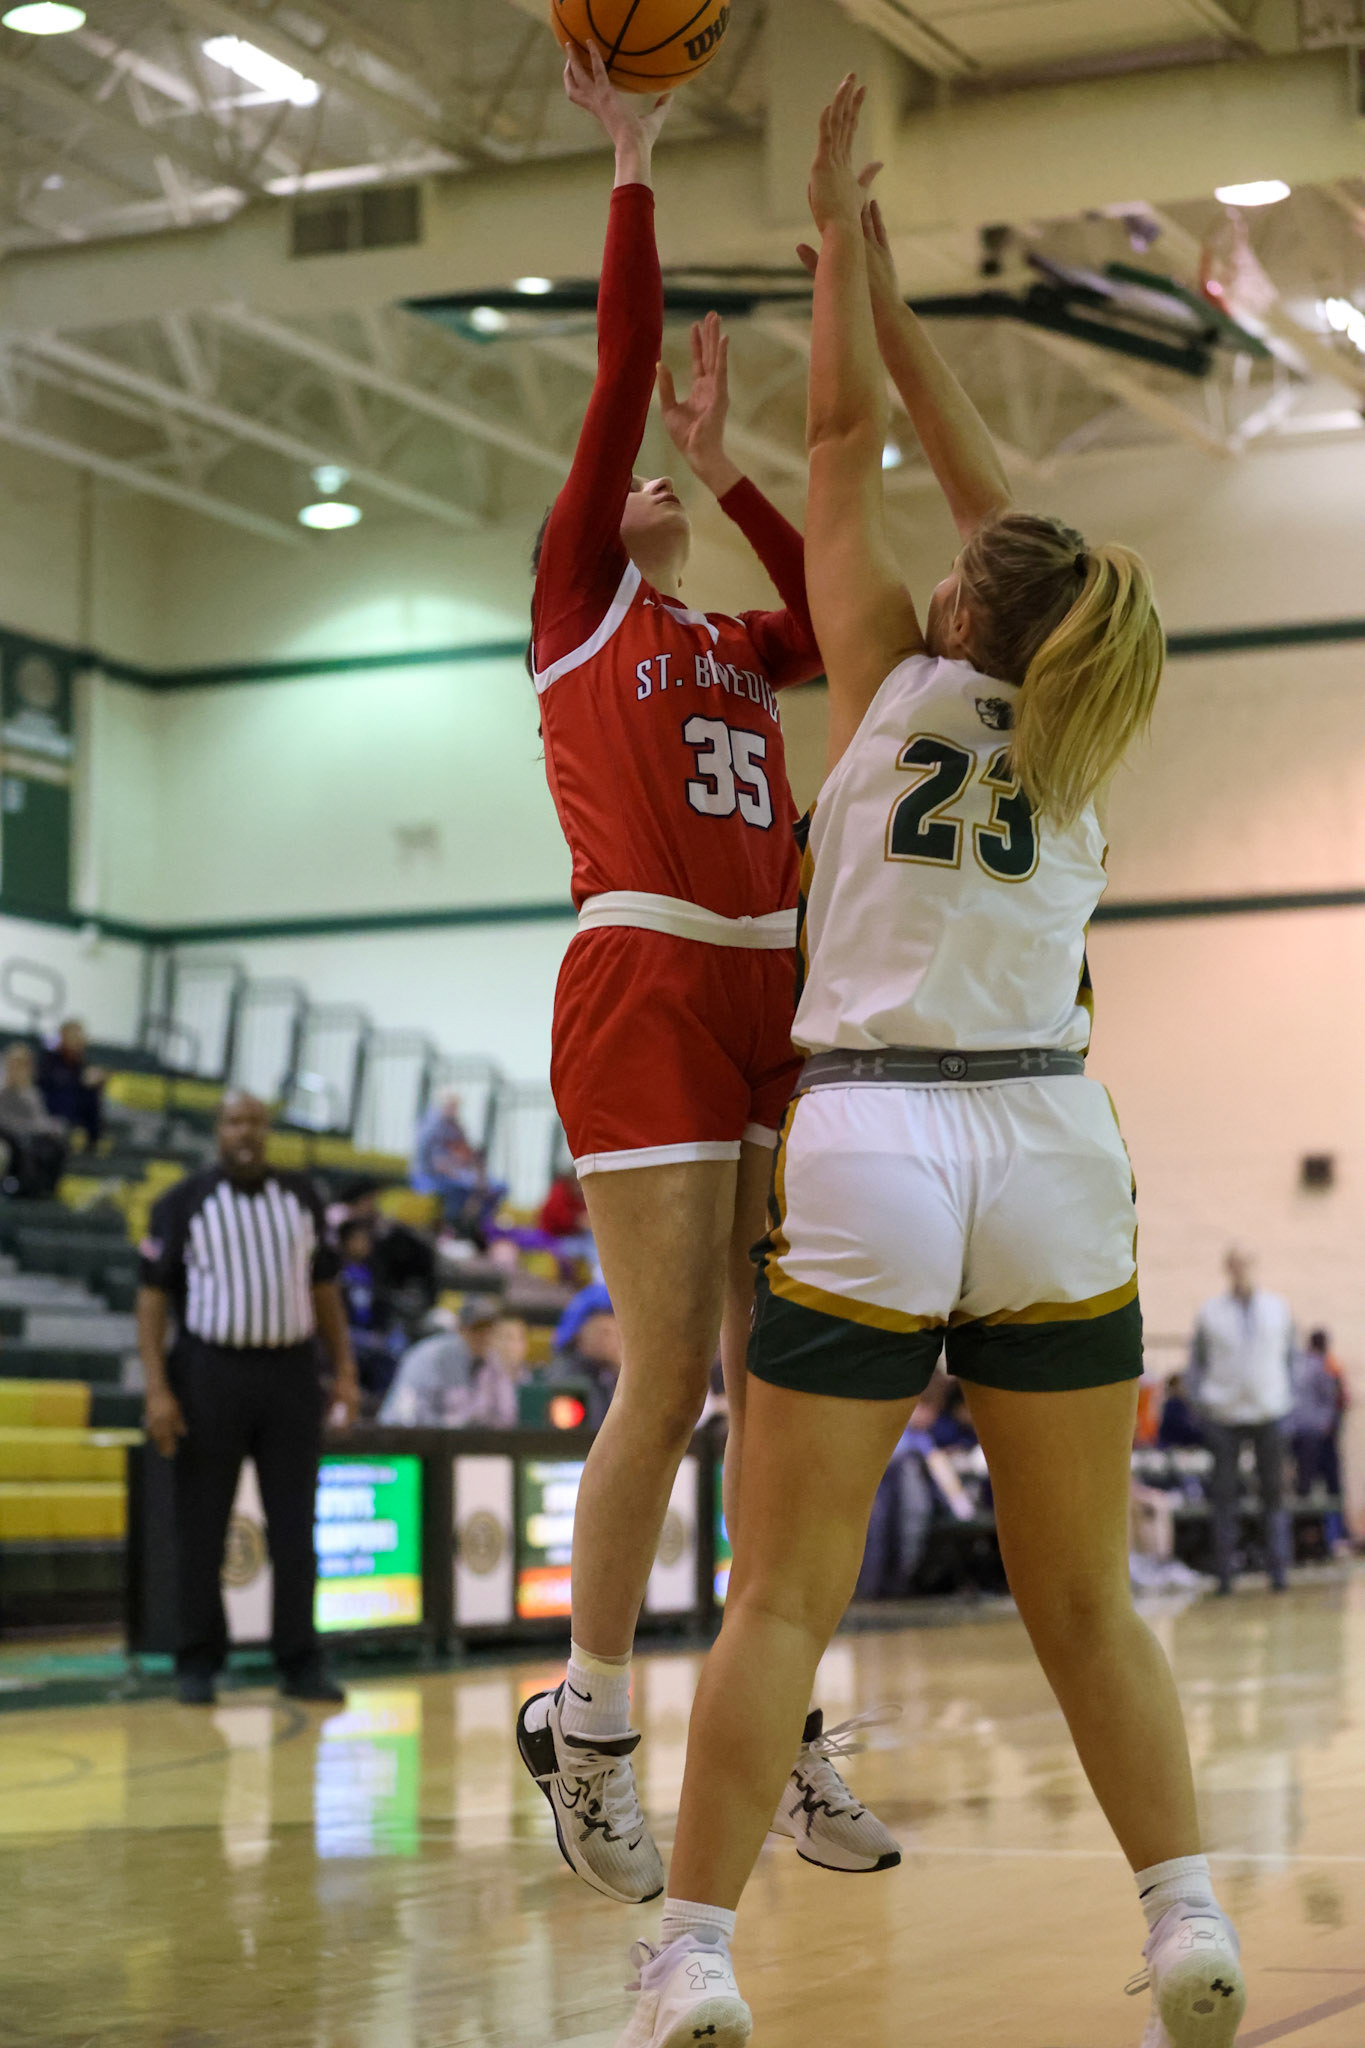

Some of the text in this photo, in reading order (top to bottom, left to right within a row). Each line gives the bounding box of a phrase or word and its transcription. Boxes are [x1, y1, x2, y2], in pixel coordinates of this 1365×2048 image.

[635, 650, 782, 728] ST. BNEDIC
[682, 713, 775, 831] 35
[884, 732, 1042, 884] 23
